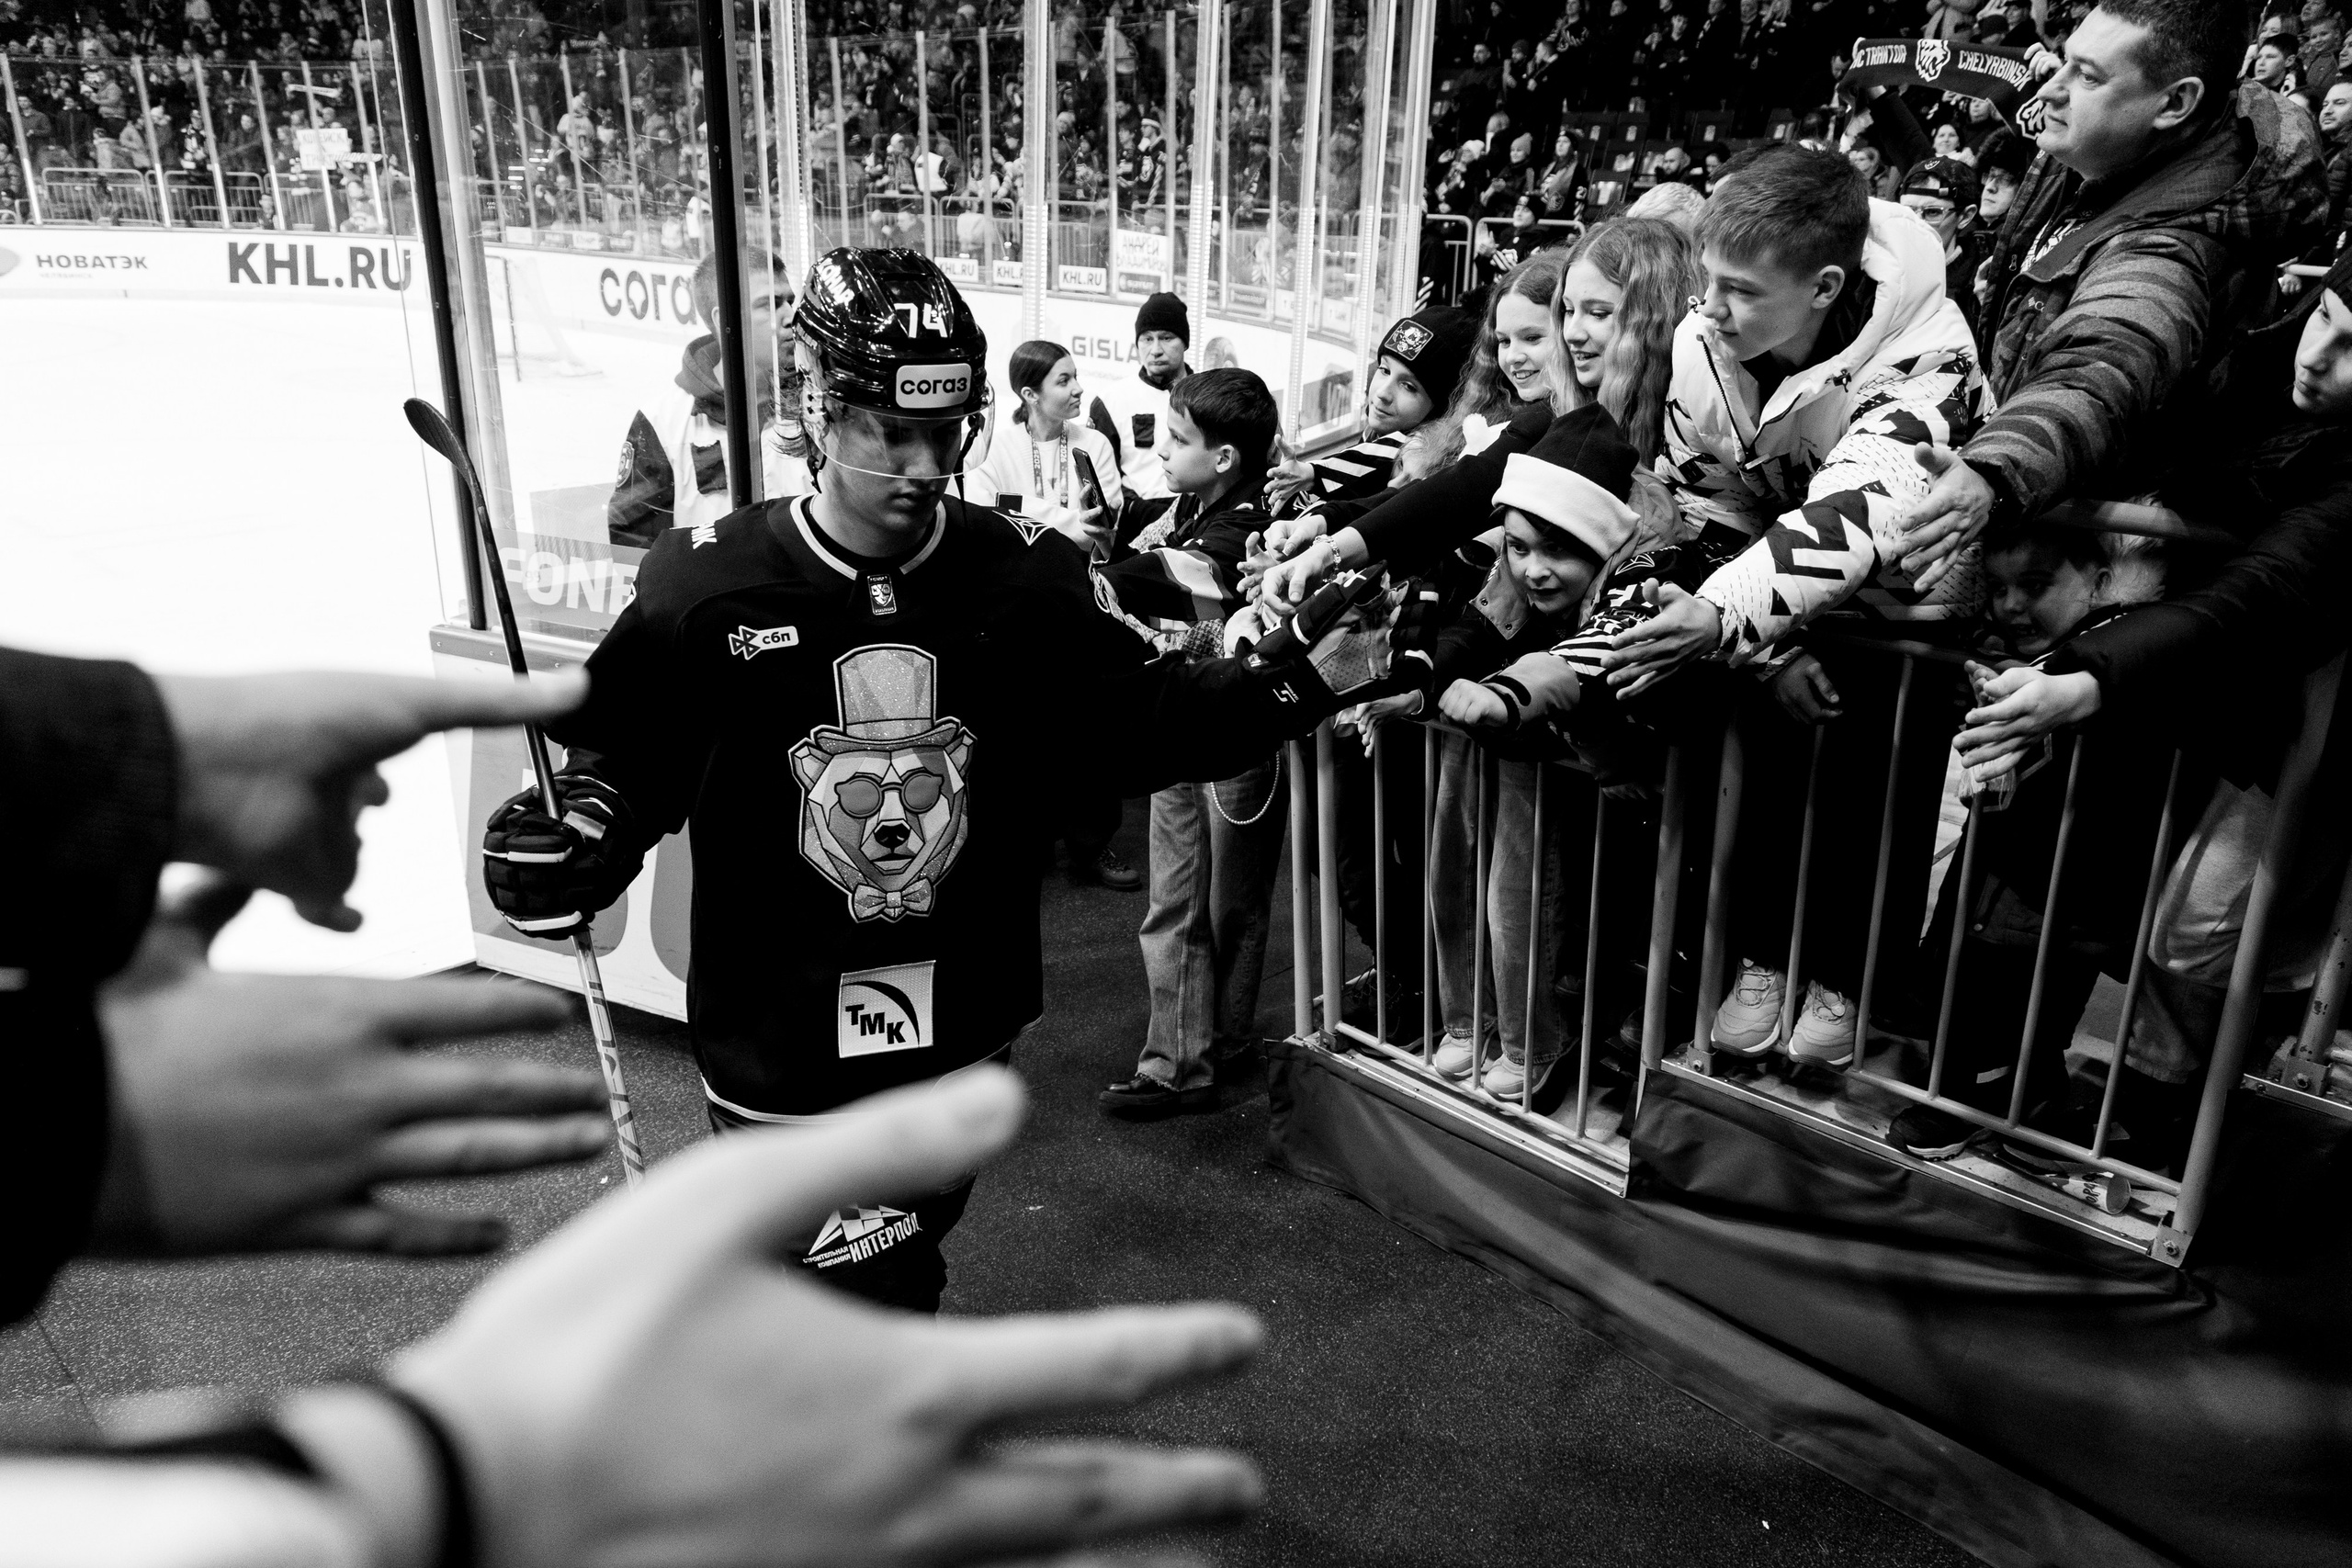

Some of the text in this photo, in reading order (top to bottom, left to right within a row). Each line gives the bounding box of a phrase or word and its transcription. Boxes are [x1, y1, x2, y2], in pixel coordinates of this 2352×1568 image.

[1958, 50, 2033, 92] CHELYABINSK
[36, 254, 148, 269] НОВАТЭК
[228, 242, 412, 291] KHL.RU
[1062, 270, 1102, 286] KHL.RU
[893, 302, 948, 339] 74
[900, 377, 967, 395] согаз
[762, 631, 791, 645] сбп
[848, 1212, 922, 1263] ИНТЕРПОЛ
[818, 1253, 852, 1269] КОМПАНИЯ
